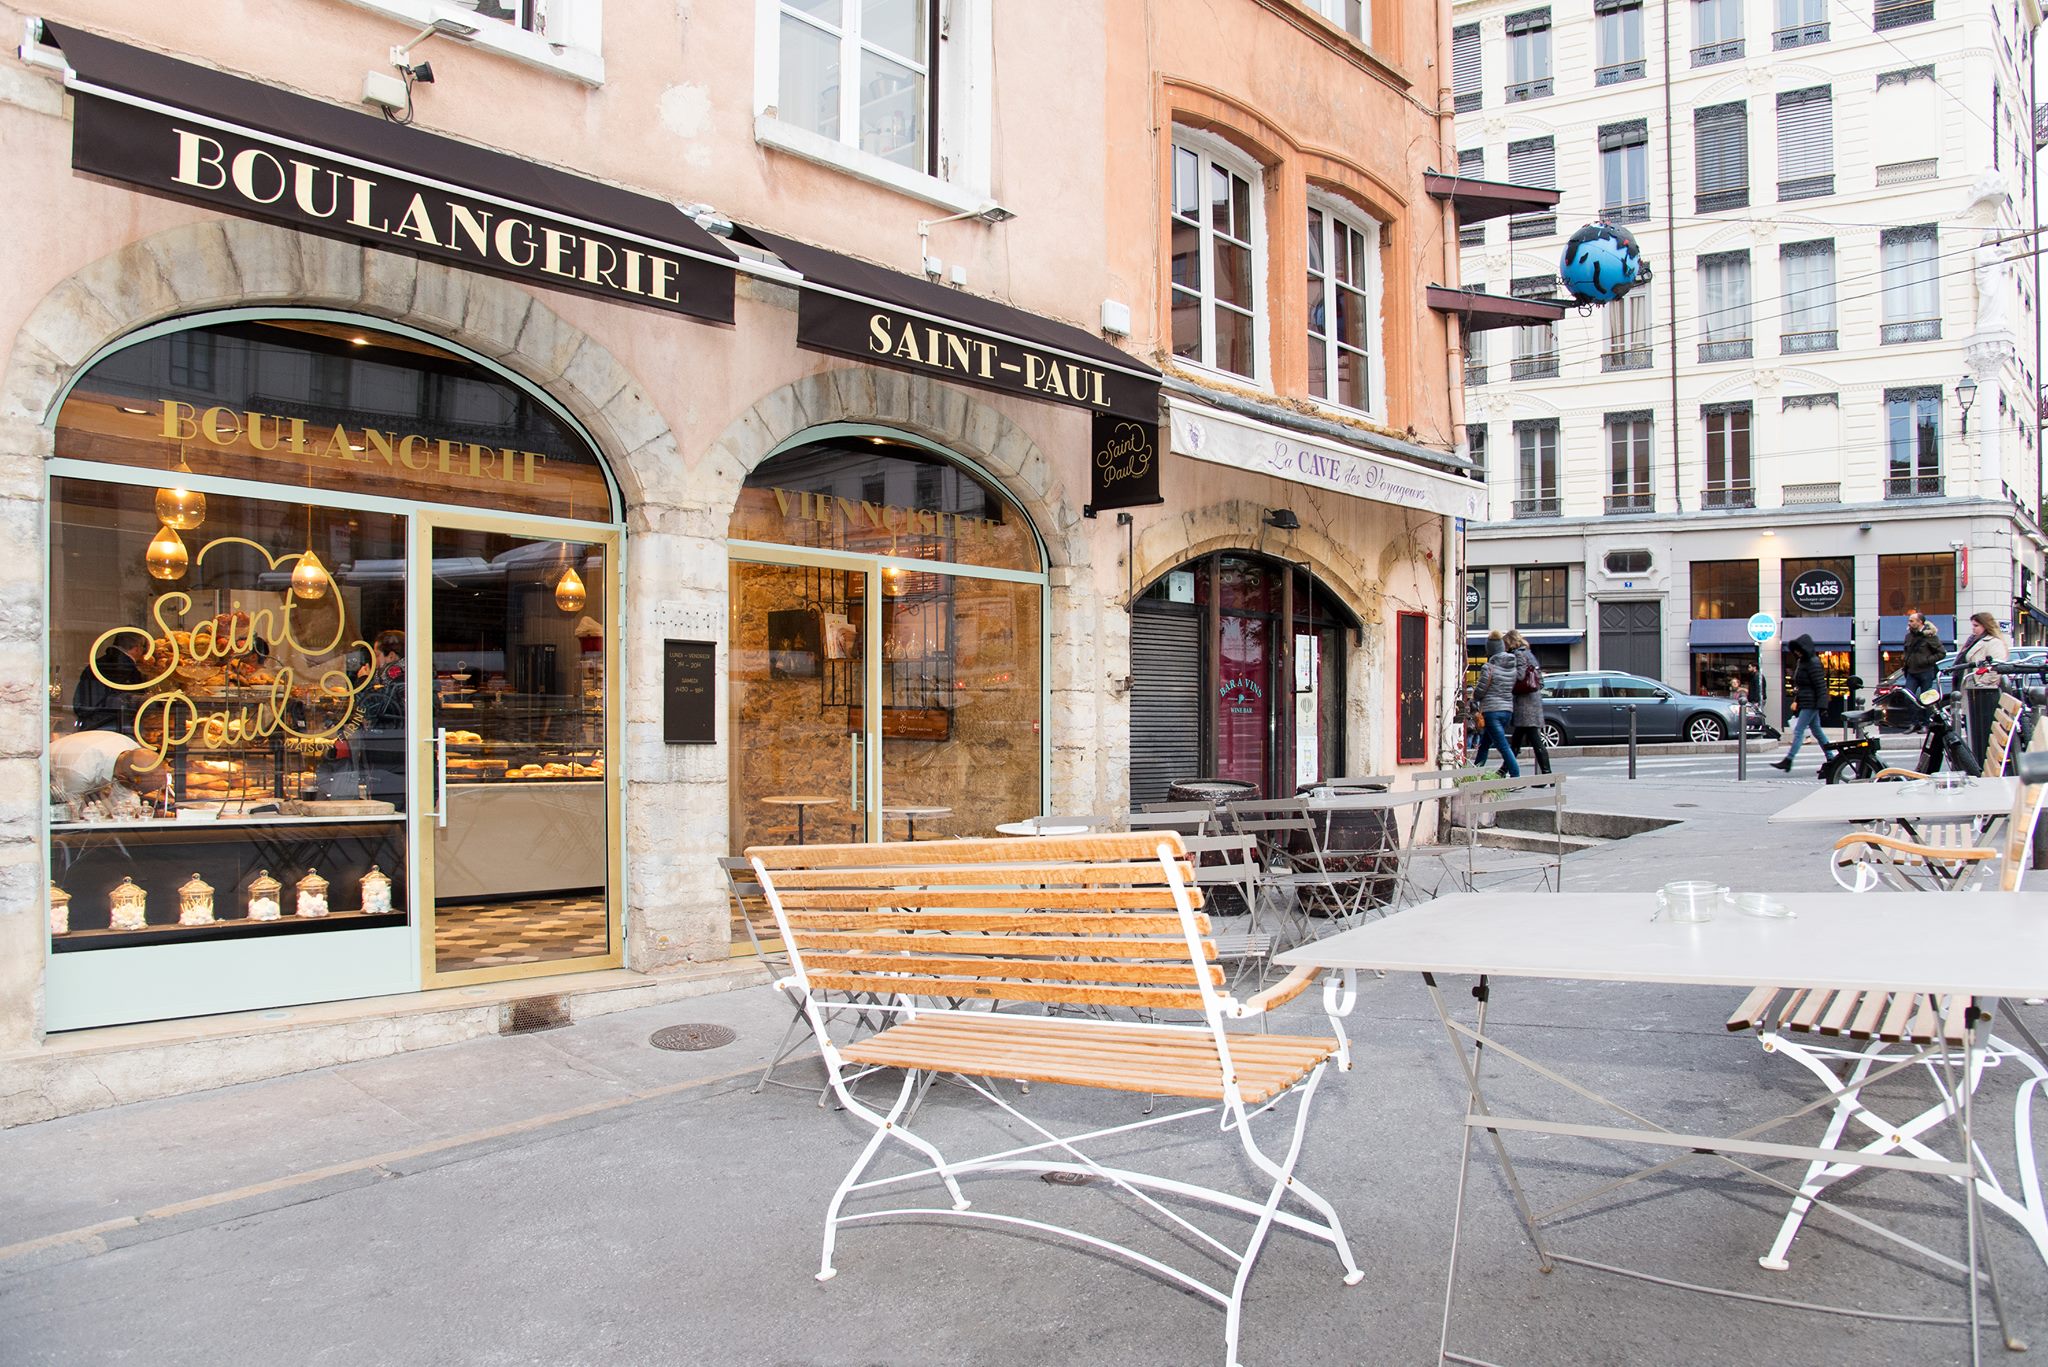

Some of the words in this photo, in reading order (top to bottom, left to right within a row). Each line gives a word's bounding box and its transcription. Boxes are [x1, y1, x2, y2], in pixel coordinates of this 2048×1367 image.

[170, 127, 680, 304] BOULANGERIE
[869, 313, 1111, 408] SAINT-PAUL
[157, 398, 547, 486] BOULANGERIE
[1097, 432, 1145, 467] Saint
[1104, 452, 1149, 487] Paul
[1267, 440, 1293, 471] La
[1298, 450, 1341, 482] CAVE
[1344, 463, 1361, 486] des
[1364, 464, 1426, 502] Voyageurs
[1796, 582, 1839, 596] Jules
[90, 582, 345, 690] Saint
[133, 660, 360, 771] Paul
[1219, 679, 1236, 697] BAR
[1245, 678, 1262, 698] VINS
[284, 738, 334, 752] MAISON
